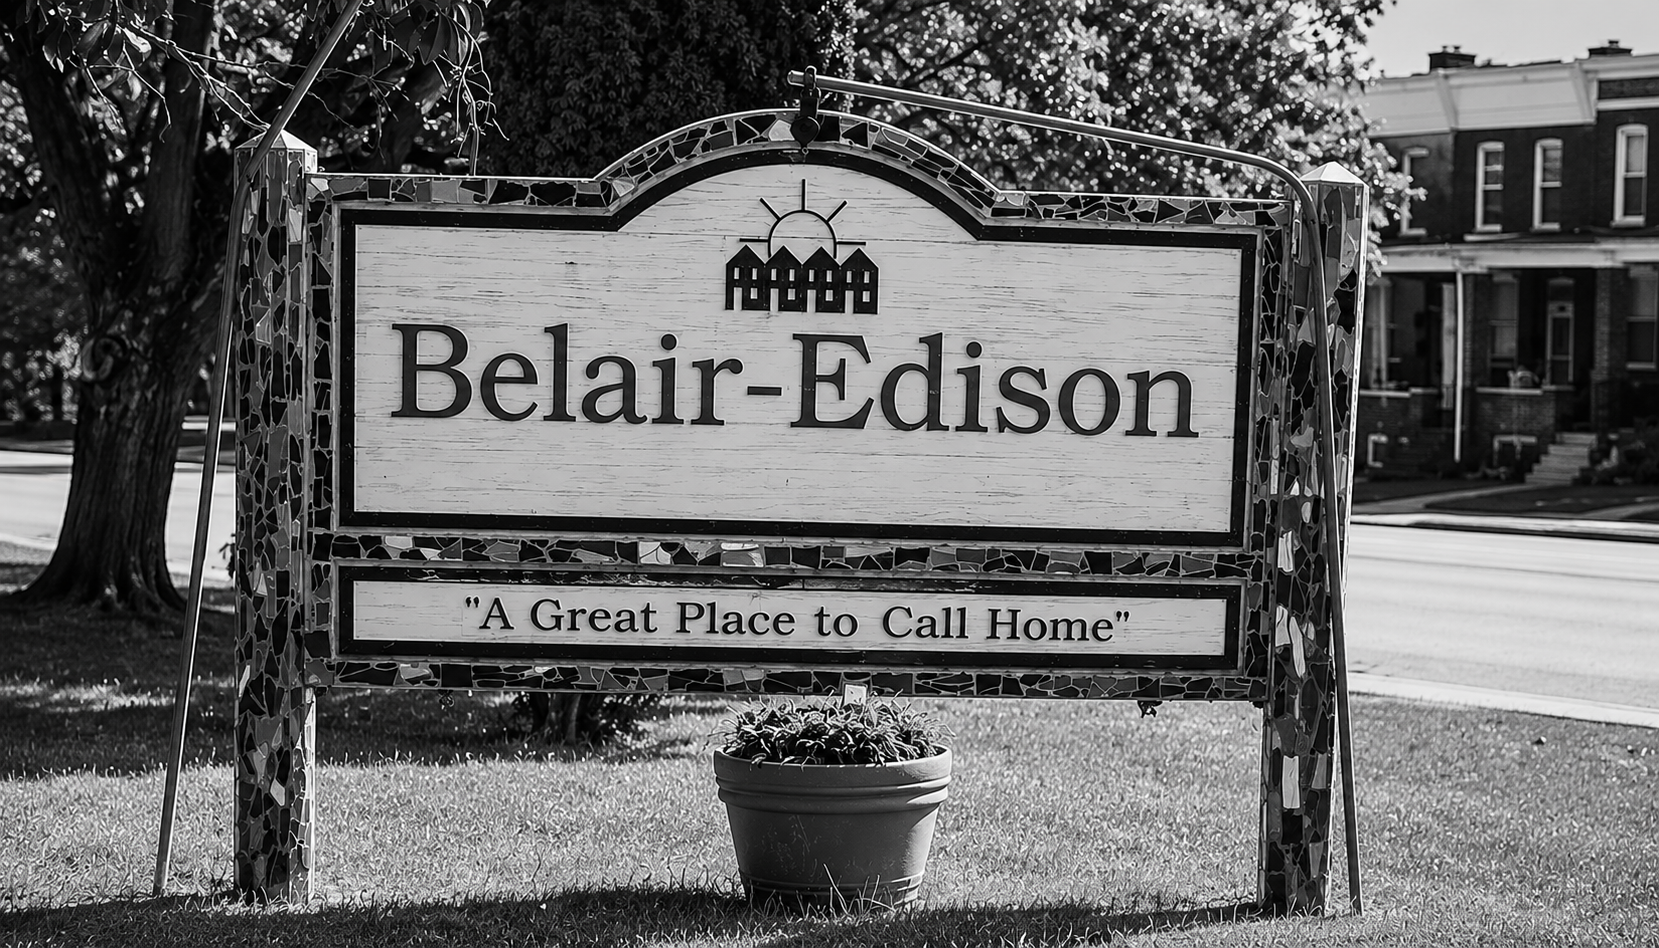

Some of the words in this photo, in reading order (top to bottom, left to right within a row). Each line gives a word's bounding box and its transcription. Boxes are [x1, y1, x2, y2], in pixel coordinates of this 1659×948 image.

[390, 322, 1200, 439] Belair-Edison
[465, 596, 515, 631] "A
[530, 598, 658, 634] Great
[675, 601, 796, 636] Place
[813, 606, 859, 638] to
[882, 606, 969, 639] Call
[985, 608, 1131, 642] Home"
